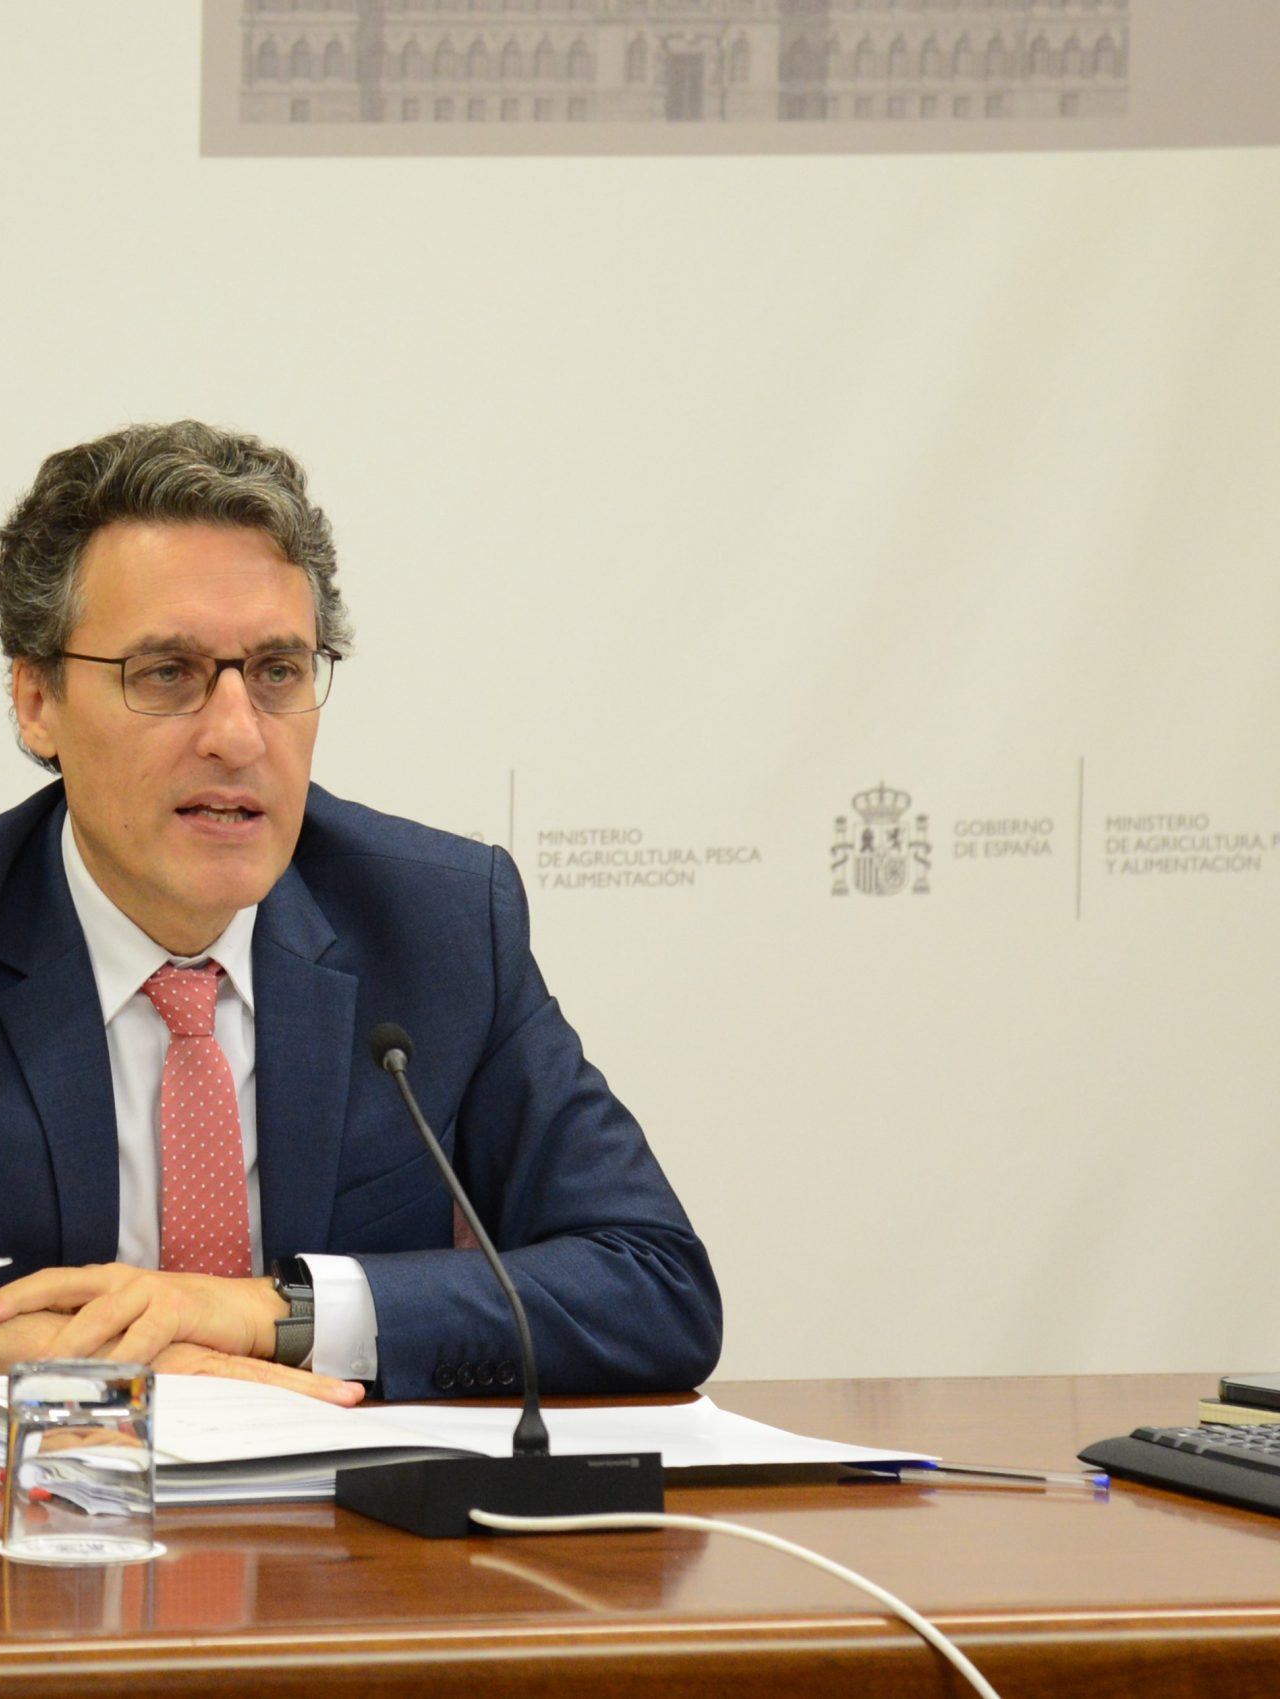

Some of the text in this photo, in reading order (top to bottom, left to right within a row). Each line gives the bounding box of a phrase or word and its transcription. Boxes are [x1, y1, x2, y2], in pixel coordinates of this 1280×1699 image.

[953, 817, 1055, 838] GOBIERNO
[1105, 812, 1211, 833] MINISTERIO
[537, 828, 644, 846] MINISTERIO
[1106, 836, 1129, 855] DE
[537, 851, 565, 868] DE
[705, 847, 763, 865] PESCA
[953, 837, 1053, 859] DE ESPAÑA
[1105, 852, 1263, 875] Y ALIMENTACIÓN
[537, 868, 696, 889] Y ALIMENTACIÓN
